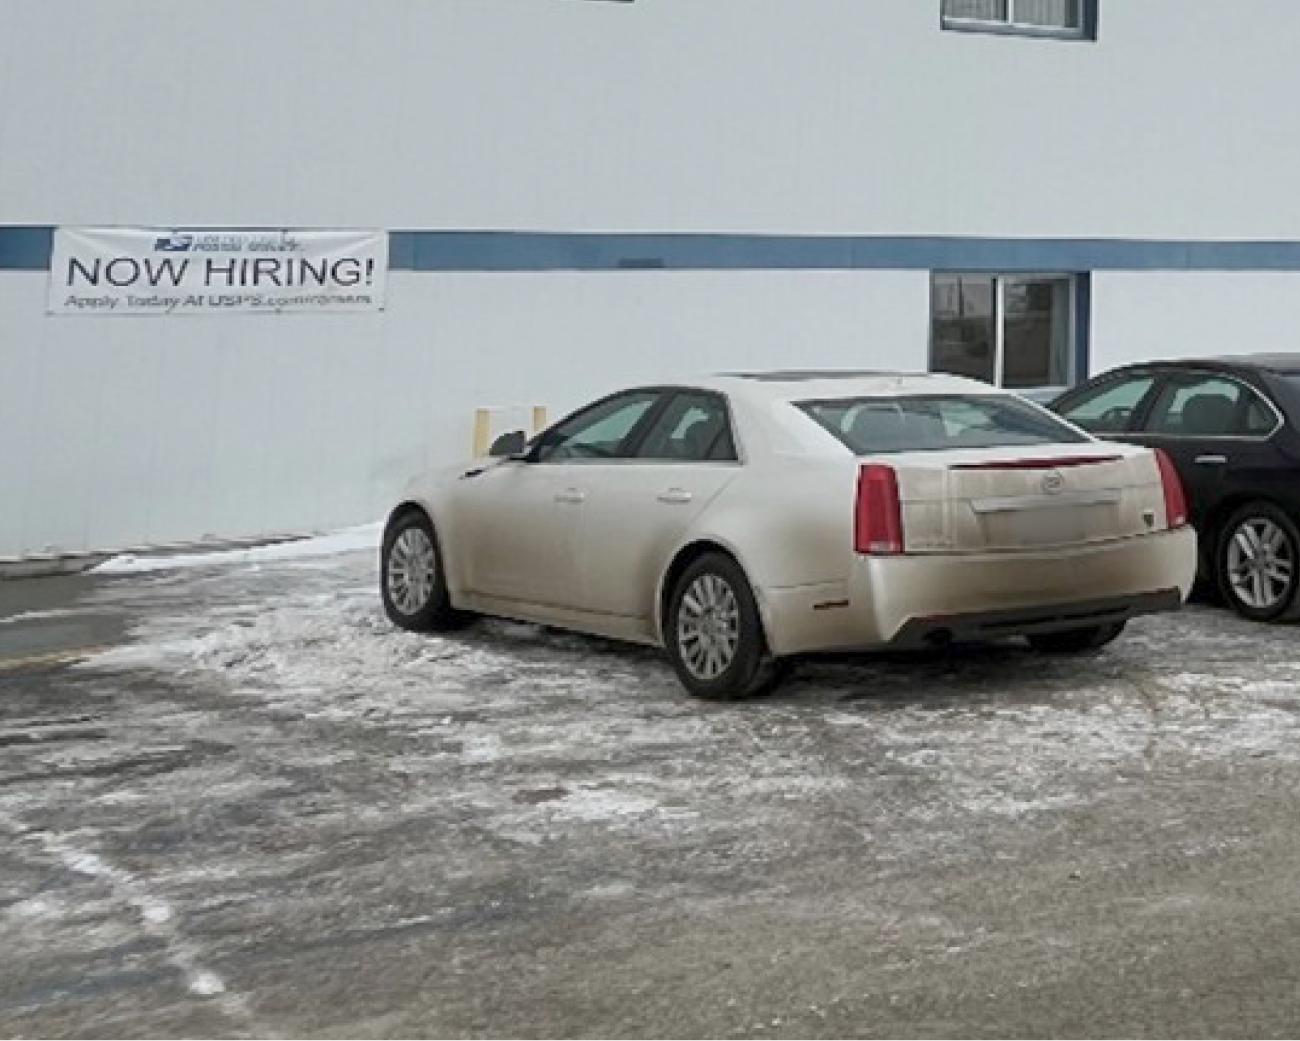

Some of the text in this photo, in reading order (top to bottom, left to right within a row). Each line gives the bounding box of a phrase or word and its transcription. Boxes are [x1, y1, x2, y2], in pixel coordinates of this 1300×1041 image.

[66, 258, 375, 287] NOW HIRING!
[63, 295, 120, 309] Apply
[127, 295, 180, 309] Today
